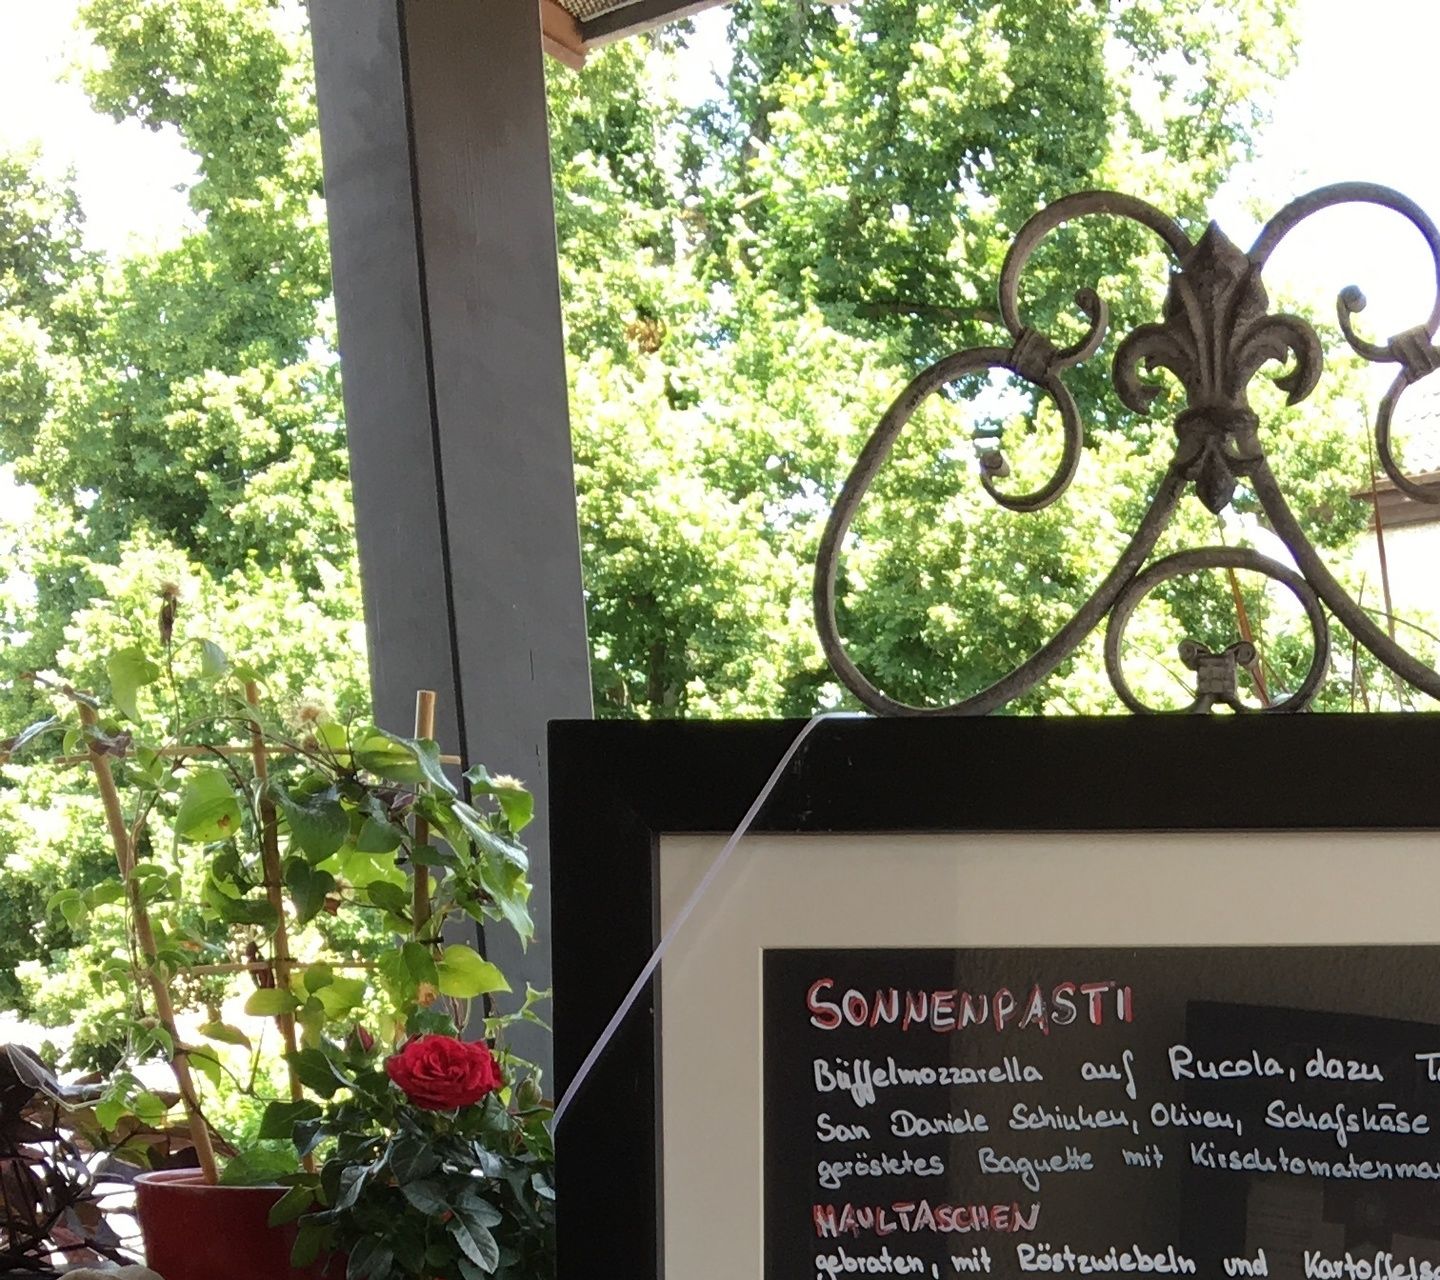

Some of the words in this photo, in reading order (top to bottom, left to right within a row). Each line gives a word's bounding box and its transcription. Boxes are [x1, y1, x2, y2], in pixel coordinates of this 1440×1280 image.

[806, 977, 1137, 1035] SONNENPASTI
[812, 1056, 1043, 1108] Büffelmozzarella
[1080, 1049, 1138, 1100] auf
[1166, 1044, 1296, 1082] Rucola,
[1305, 1048, 1384, 1082] dazu
[816, 1113, 870, 1143] San
[1009, 1104, 1140, 1135] Schinken,
[1151, 1103, 1243, 1136] Oliven,
[1264, 1100, 1430, 1148] Schafskäse
[817, 1147, 945, 1190] geröstetes
[978, 1146, 1095, 1192] Baguette
[1122, 1141, 1164, 1169] mit
[812, 1200, 1041, 1238] MAULTASCHEN
[951, 1247, 992, 1274] mit
[1016, 1242, 1197, 1275] Röstzwiebeln
[1223, 1248, 1268, 1277] und
